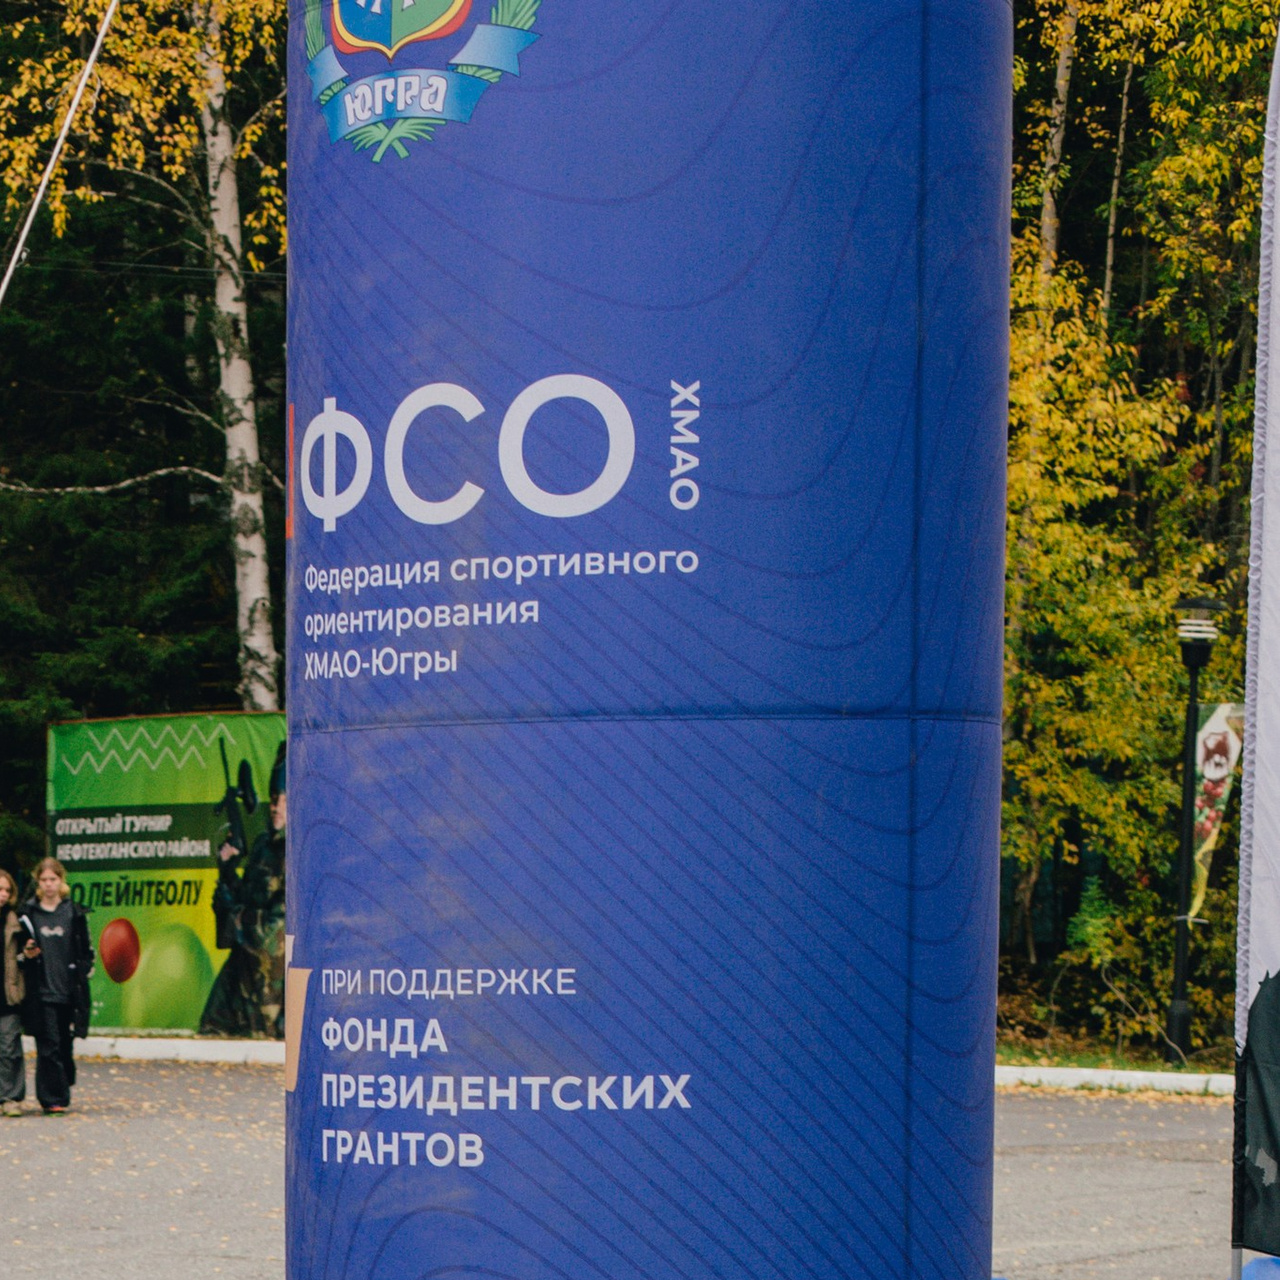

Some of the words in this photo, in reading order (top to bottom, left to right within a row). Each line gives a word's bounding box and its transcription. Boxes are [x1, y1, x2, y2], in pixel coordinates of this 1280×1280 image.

[344, 75, 447, 127] ЮГРА
[300, 373, 636, 533] ФСО
[669, 379, 700, 511] ХМАО
[304, 560, 440, 596] Федерация
[449, 549, 699, 586] спортивного
[304, 599, 540, 637] ориентирования
[304, 646, 458, 681] ХМАО-Югры
[55, 813, 122, 836] ОТКРЫТЫЙ
[124, 814, 173, 833] ТУРНИР
[56, 841, 166, 861] НЕФТЕЮГАНСКОГО
[166, 836, 211, 857] РАЙОНА
[322, 969, 362, 995] ПРИ
[369, 968, 577, 1000] ПОДДЕРЖКЕ
[321, 1017, 449, 1058] ФОНДА
[322, 1073, 692, 1116] ПРЕЗИДЕНТСКИХ
[322, 1129, 485, 1168] ГРАНТОВ
